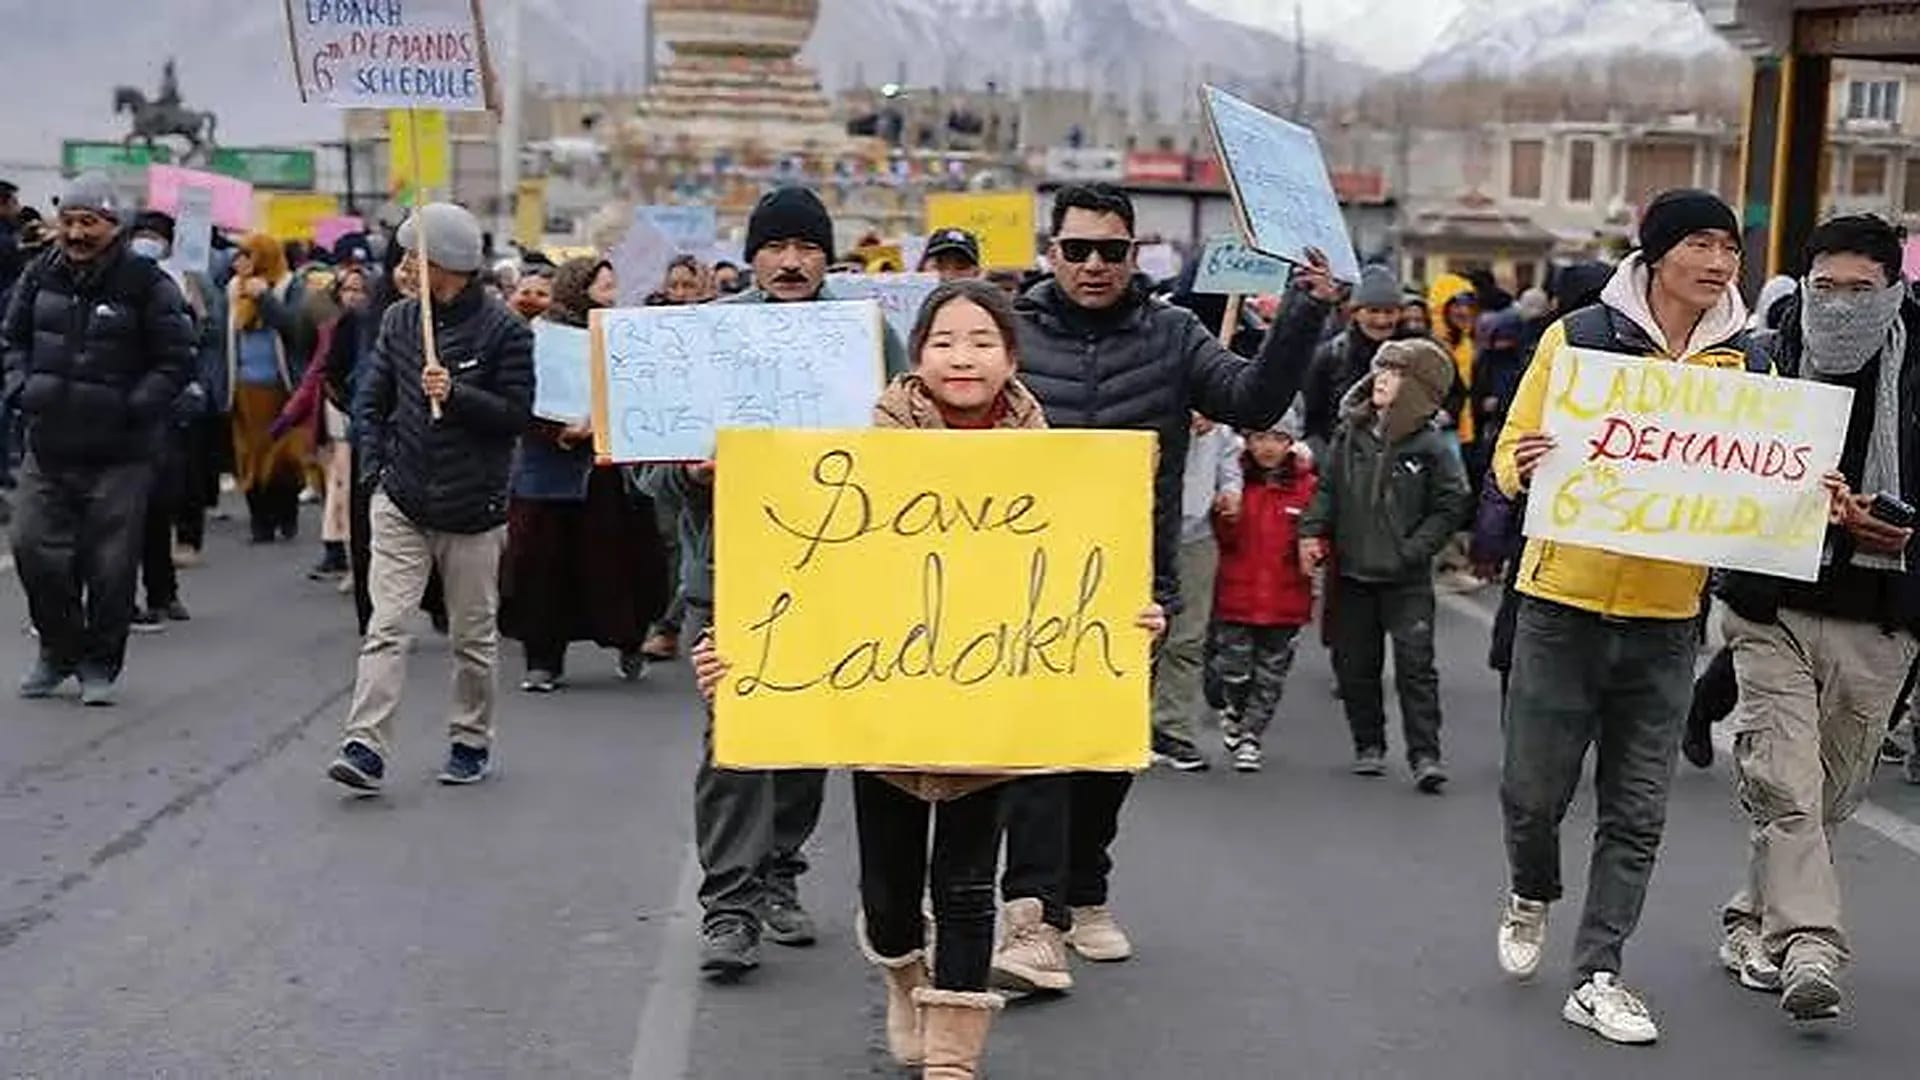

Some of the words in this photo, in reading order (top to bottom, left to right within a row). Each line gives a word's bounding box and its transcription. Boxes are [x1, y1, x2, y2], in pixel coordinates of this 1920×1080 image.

[350, 31, 472, 62] DEMANDS
[355, 67, 477, 98] SCHEDULE
[1588, 418, 1812, 480] DEMANDS
[762, 449, 1049, 570] Save
[1598, 487, 1824, 546] SCHED
[735, 546, 1126, 695] Ladakh
